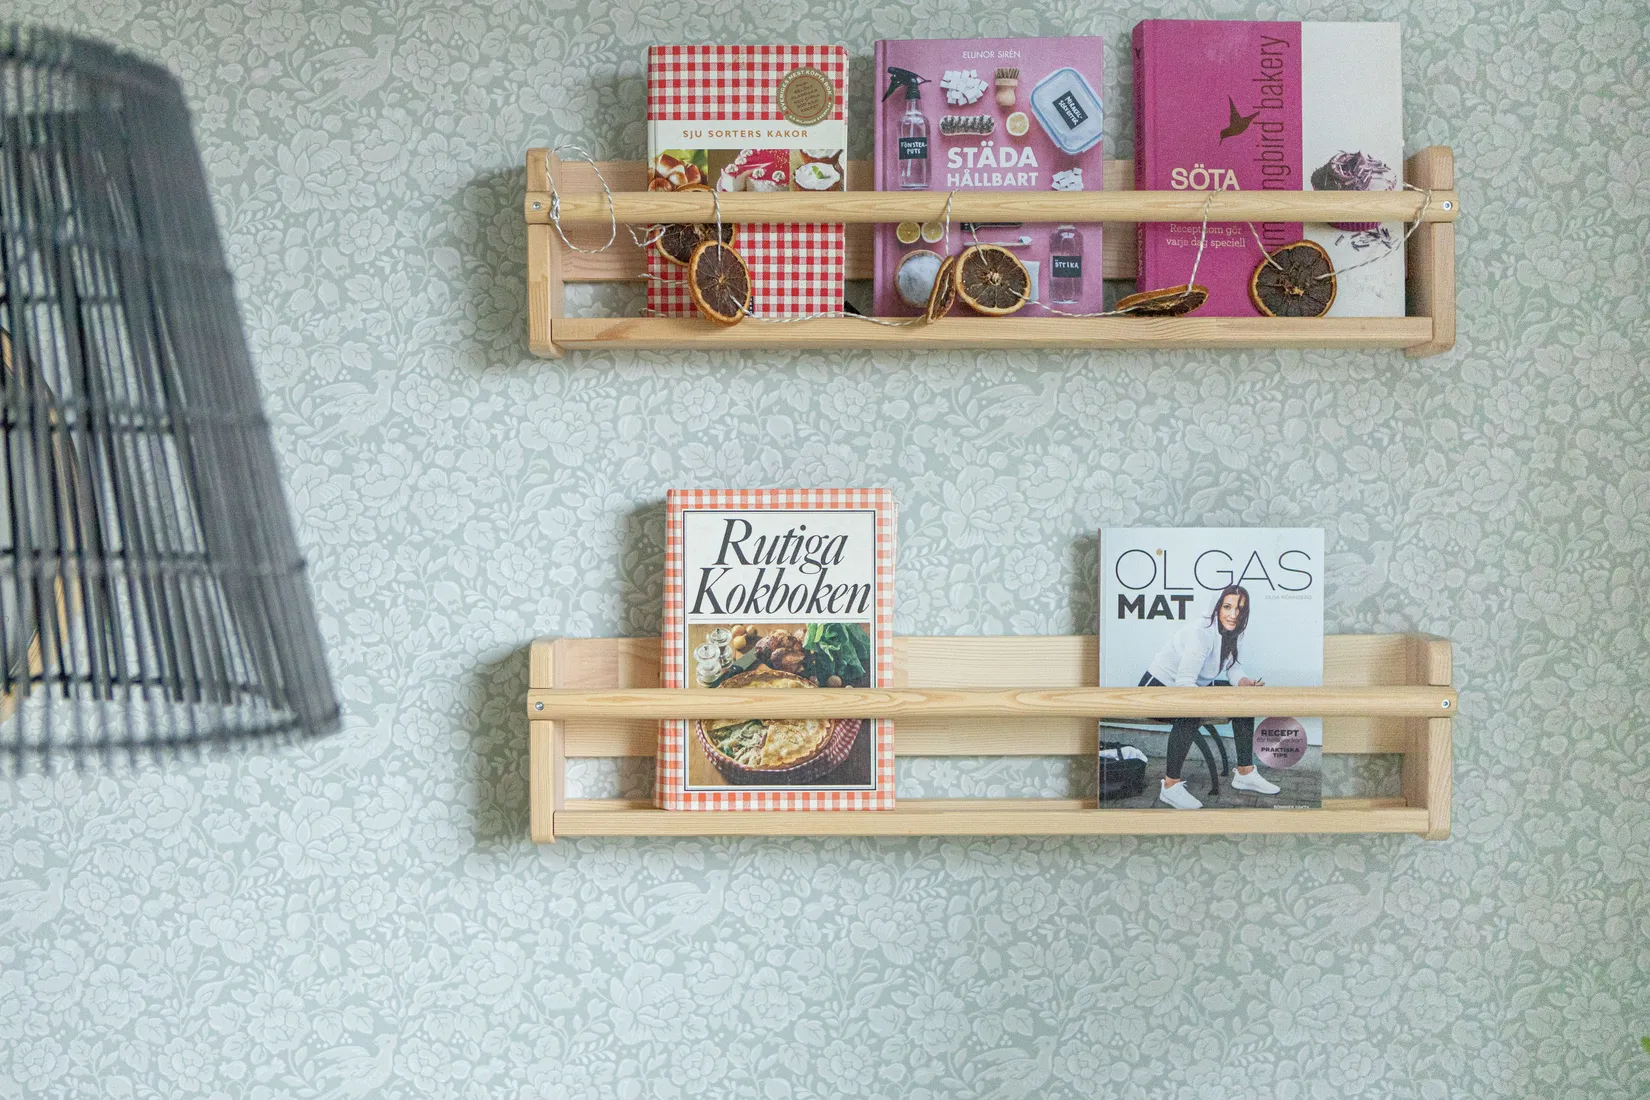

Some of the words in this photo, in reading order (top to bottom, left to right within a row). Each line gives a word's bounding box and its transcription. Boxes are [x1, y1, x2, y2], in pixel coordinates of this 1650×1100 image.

[997, 49, 1021, 59] SIRÉN
[1252, 34, 1290, 110] bakery
[682, 129, 703, 140] SJU
[707, 129, 761, 138] SORTERS
[766, 129, 808, 138] KAKOR
[947, 141, 1039, 169] STÄDA
[947, 169, 1039, 187] HÅLLBART
[1170, 163, 1240, 191] SÖTA
[1166, 237, 1189, 248] varje
[1210, 237, 1246, 248] speciell
[1225, 226, 1242, 236] gör
[711, 518, 849, 575] Rutiga
[1115, 549, 1313, 592] OLGAS
[687, 566, 872, 615] Kokboken
[1117, 593, 1194, 620] MAT
